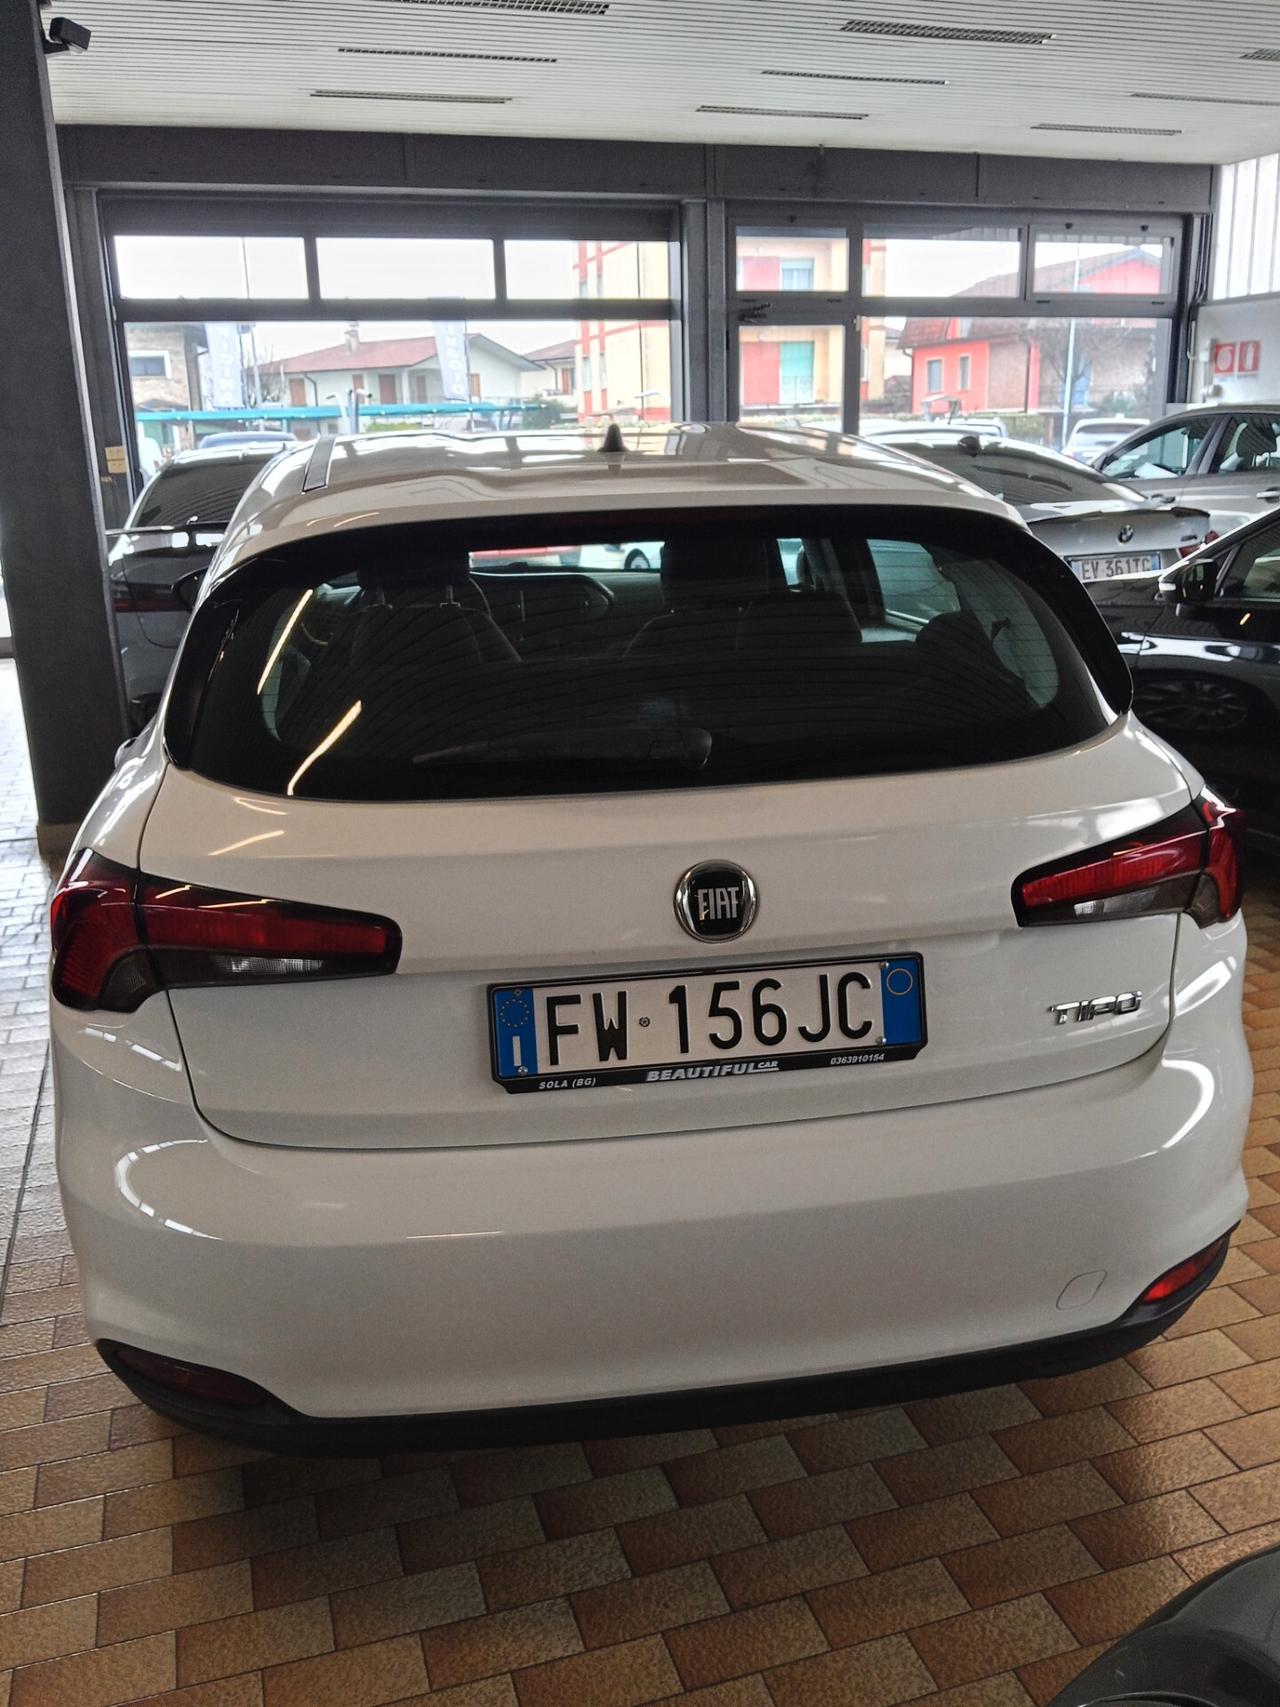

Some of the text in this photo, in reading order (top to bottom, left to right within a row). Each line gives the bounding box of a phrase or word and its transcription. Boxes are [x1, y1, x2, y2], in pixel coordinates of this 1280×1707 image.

[1081, 561, 1099, 580] EV
[697, 886, 739, 920] FIAT
[546, 972, 873, 1066] FW 156JC
[1047, 990, 1142, 1026] TIPO
[512, 1035, 521, 1067] I
[830, 1053, 885, 1065] 0363910154
[539, 1077, 596, 1089] SOLA (BG)
[645, 1060, 779, 1082] BEAUTIFUL CAR
